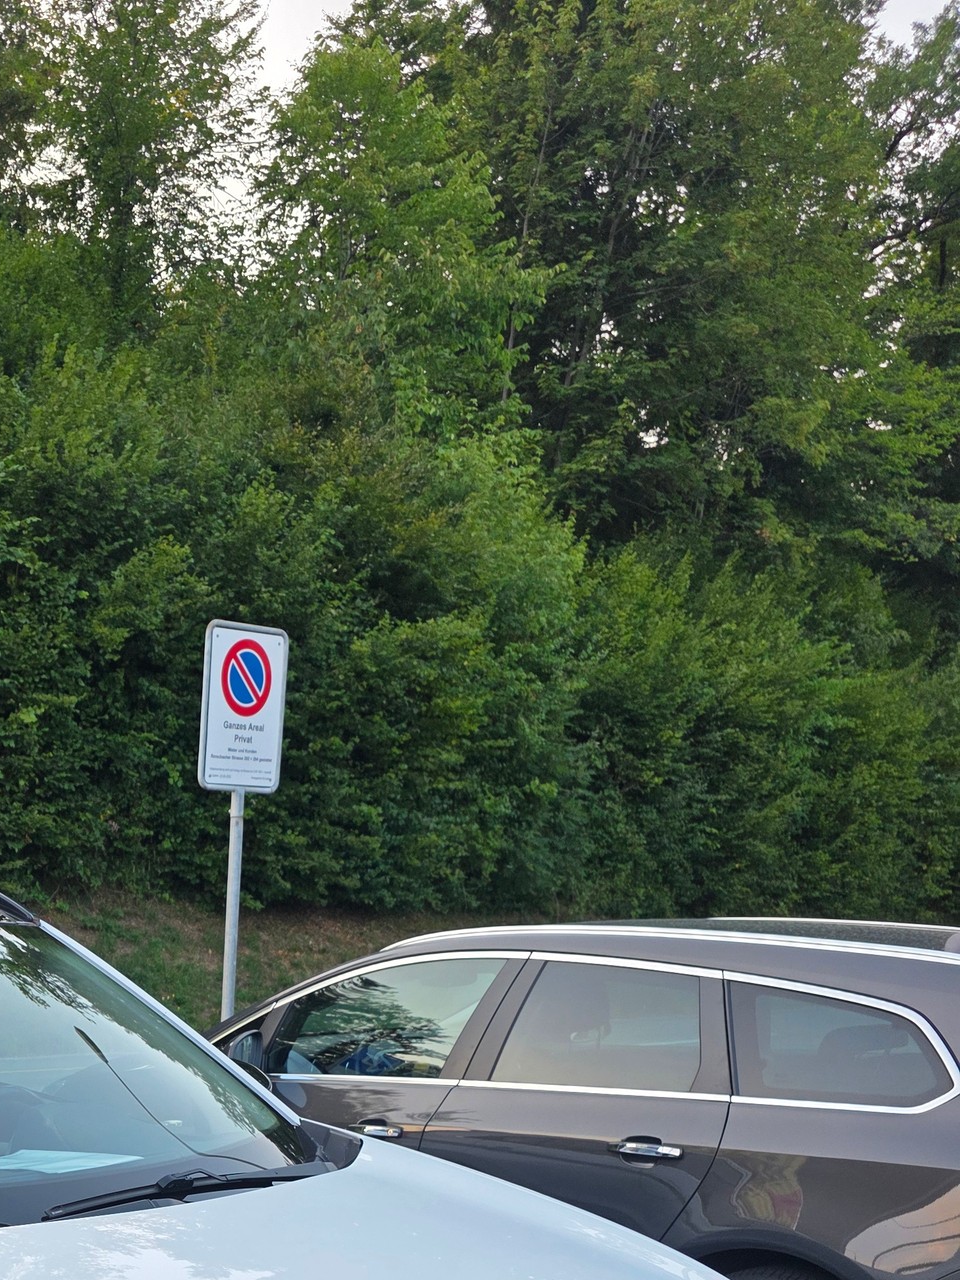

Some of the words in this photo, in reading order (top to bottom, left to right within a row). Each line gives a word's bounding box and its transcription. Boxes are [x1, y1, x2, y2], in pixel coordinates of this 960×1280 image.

[223, 720, 247, 731] Ganzes
[247, 723, 265, 732] Areal
[234, 734, 253, 744] Privat
